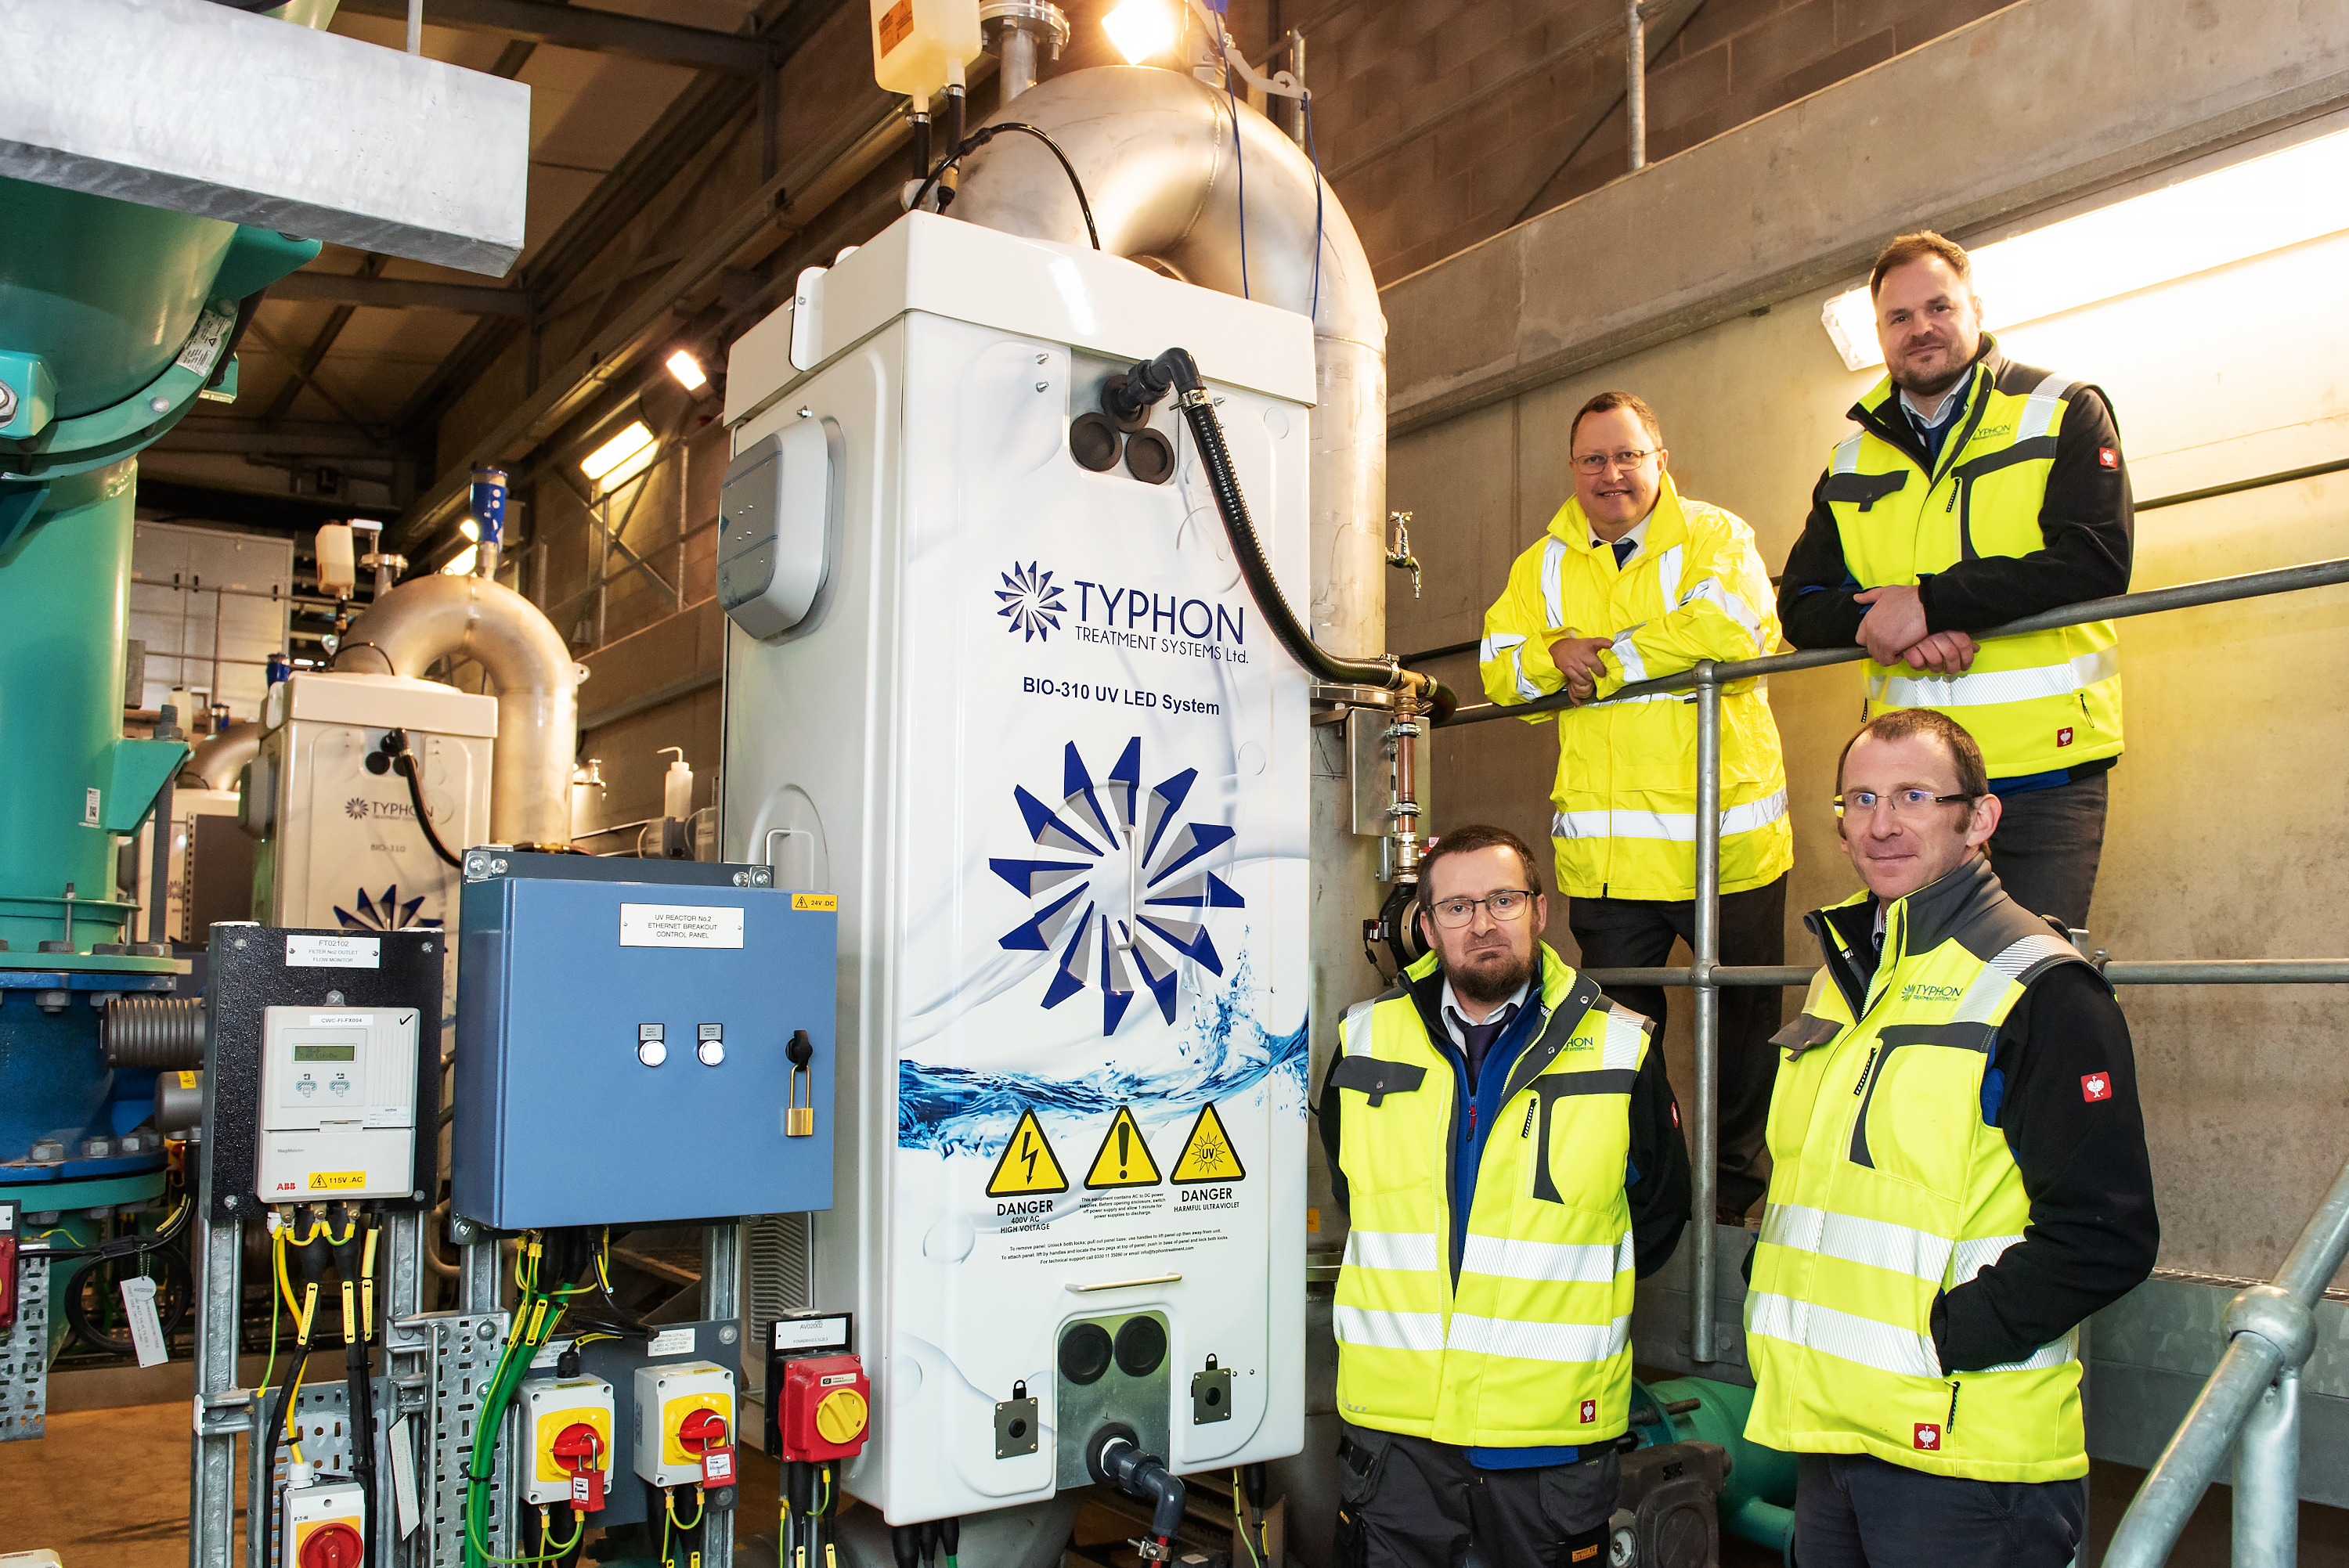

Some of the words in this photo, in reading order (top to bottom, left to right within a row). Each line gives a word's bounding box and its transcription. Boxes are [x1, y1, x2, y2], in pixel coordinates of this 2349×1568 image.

[1074, 580, 1243, 645] TYPHON
[1075, 626, 1156, 651] TREATMENT
[1161, 639, 1221, 659] SYSTEMS
[1226, 647, 1250, 664] Ltd.
[1024, 677, 1090, 700] BIO-310
[1096, 686, 1118, 703] UV
[1125, 689, 1156, 708] LED
[1163, 694, 1220, 716] System
[1916, 984, 1964, 997] TYPHON
[1202, 1148, 1214, 1159] UV
[276, 1182, 296, 1191] ABB
[1182, 1188, 1232, 1202] DANGER
[998, 1200, 1053, 1217] DANGER
[1203, 1202, 1239, 1210] ULTRAVIOLET
[1019, 1224, 1050, 1232] VOLTAGE
